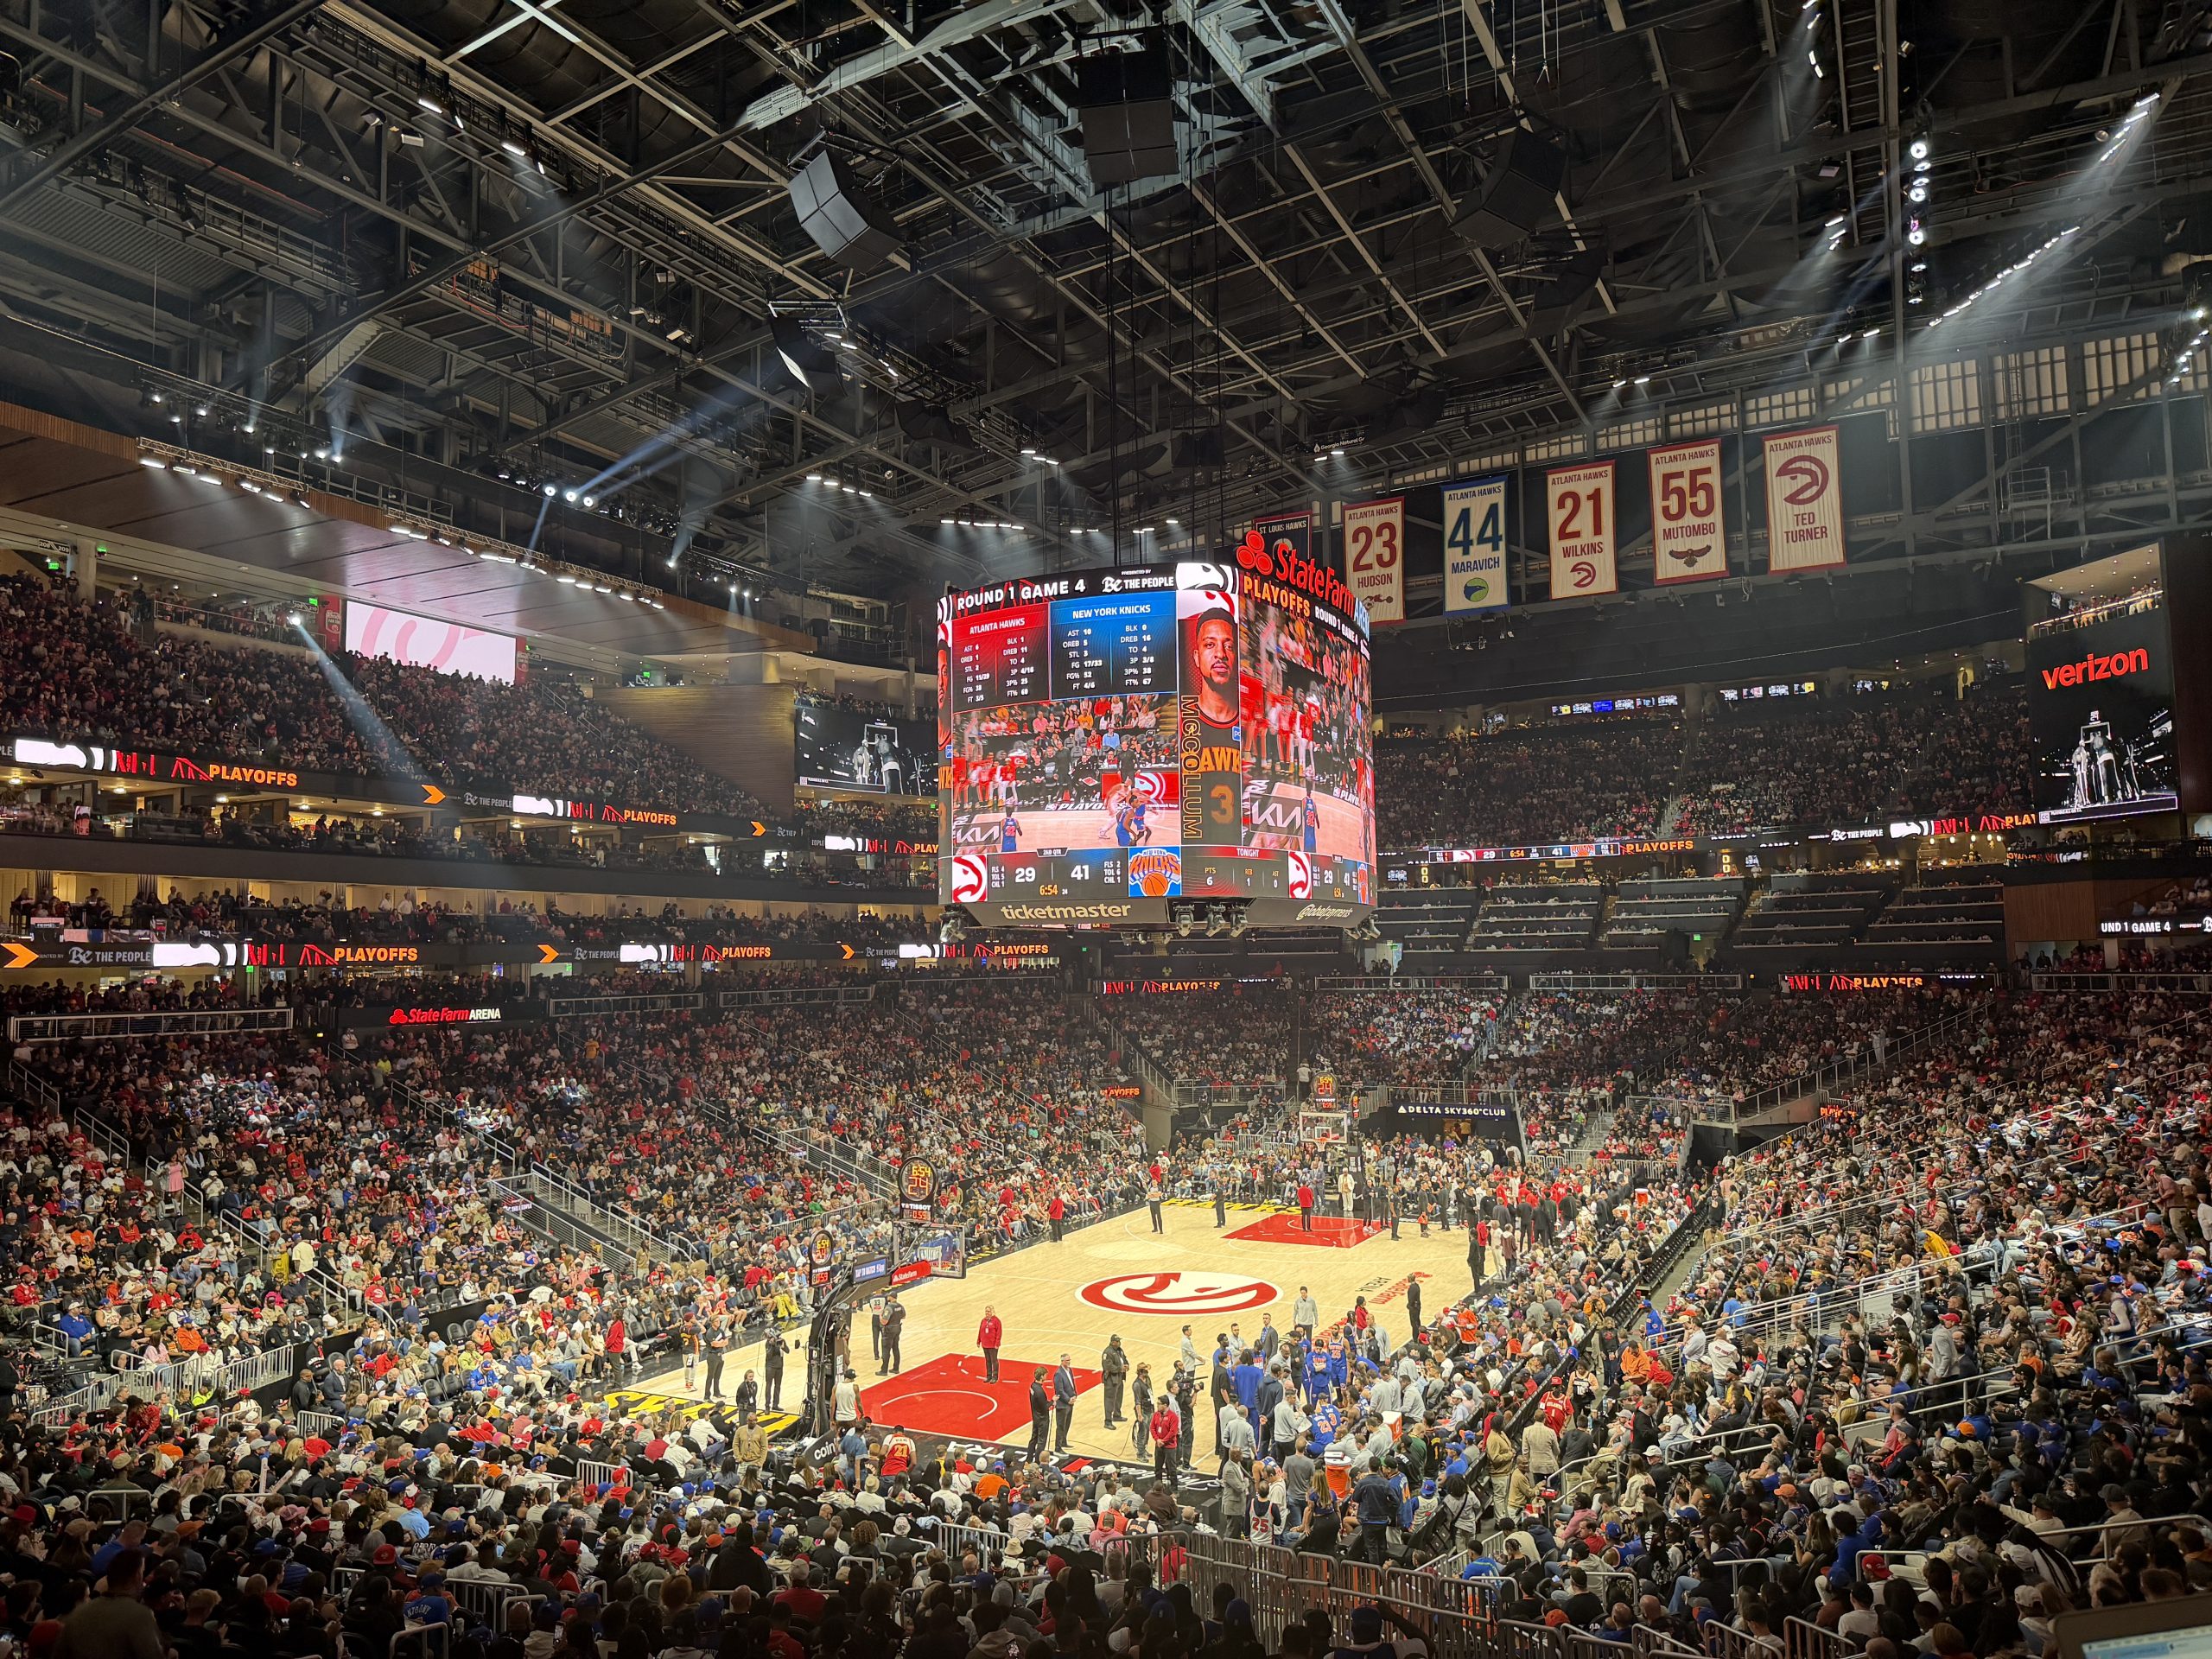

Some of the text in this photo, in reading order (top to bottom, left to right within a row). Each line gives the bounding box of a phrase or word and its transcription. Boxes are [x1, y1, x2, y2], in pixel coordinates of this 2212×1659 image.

[1770, 435, 1832, 453] ATLANTA HAWKS
[1656, 448, 1714, 466] ATLANTA HAWKS
[1552, 470, 1608, 486] ATLANTA HAWKS
[1448, 486, 1502, 501] ATLANTA HAWKS
[1662, 467, 1715, 521] 55
[1348, 506, 1398, 521] ATLANTA HAWKS
[1557, 487, 1602, 541] 21
[1794, 512, 1815, 527] TED
[1268, 524, 1284, 533] LOUIS
[1286, 520, 1306, 531] HAWKS
[1447, 502, 1503, 556] 44
[1662, 522, 1716, 541] MUTOMBO
[1784, 526, 1828, 544] TURNER
[1351, 522, 1397, 573] 23
[1562, 541, 1604, 558] WILKINS
[1452, 556, 1500, 575] MARAVICH
[1123, 578, 1141, 589] THE
[1141, 576, 1174, 588] PEOPLE
[1357, 572, 1393, 588] HUDSON
[957, 579, 1086, 610] ROUND 1 GAME 4
[1243, 575, 1310, 618] PLAYOFFS
[1072, 605, 1151, 619] NEW YORK KNICKS
[1315, 606, 1338, 628] ROUND
[969, 617, 1026, 635] ATLANTA HAWKS
[2041, 648, 2149, 690] verizon
[209, 764, 298, 787] PLAYOFFS
[479, 797, 490, 807] THE
[491, 797, 512, 809] PEOPLE
[1210, 783, 1235, 826] 3
[624, 809, 677, 826] PLAYOFFS
[1847, 831, 1859, 840] THE
[1859, 829, 1884, 838] PEOPLE
[1236, 849, 1260, 857] TONIGHT
[1483, 850, 1496, 859] 29
[1626, 840, 1694, 853] PLAYOFFS
[1130, 853, 1180, 874] KNICKS
[1014, 864, 1090, 883] 29 41
[1324, 869, 1333, 885] 29
[1344, 873, 1351, 887] 41
[1206, 876, 1278, 888] 6 1 0
[1039, 885, 1058, 896] 6:54
[1001, 902, 1132, 921] ticketmaster
[2101, 921, 2171, 933] UND 1 GAME 4
[95, 950, 114, 963] THE
[116, 950, 151, 963] PEOPLE
[334, 946, 418, 963] PLAYOFFS
[588, 950, 599, 959] THE
[600, 950, 620, 959] PEOPLE
[721, 946, 771, 958] PLAYOFFS
[994, 945, 1049, 956] PLAYOFFS
[469, 1008, 501, 1020] ARENA
[1408, 1106, 1441, 1115] DELTA
[912, 1165, 931, 1177] 6:54
[907, 1177, 930, 1197] 24
[1317, 1421, 1333, 1433] 23
[1329, 1414, 1338, 1426] 3
[814, 1443, 836, 1460] coin
[1253, 1517, 1269, 1533] 25
